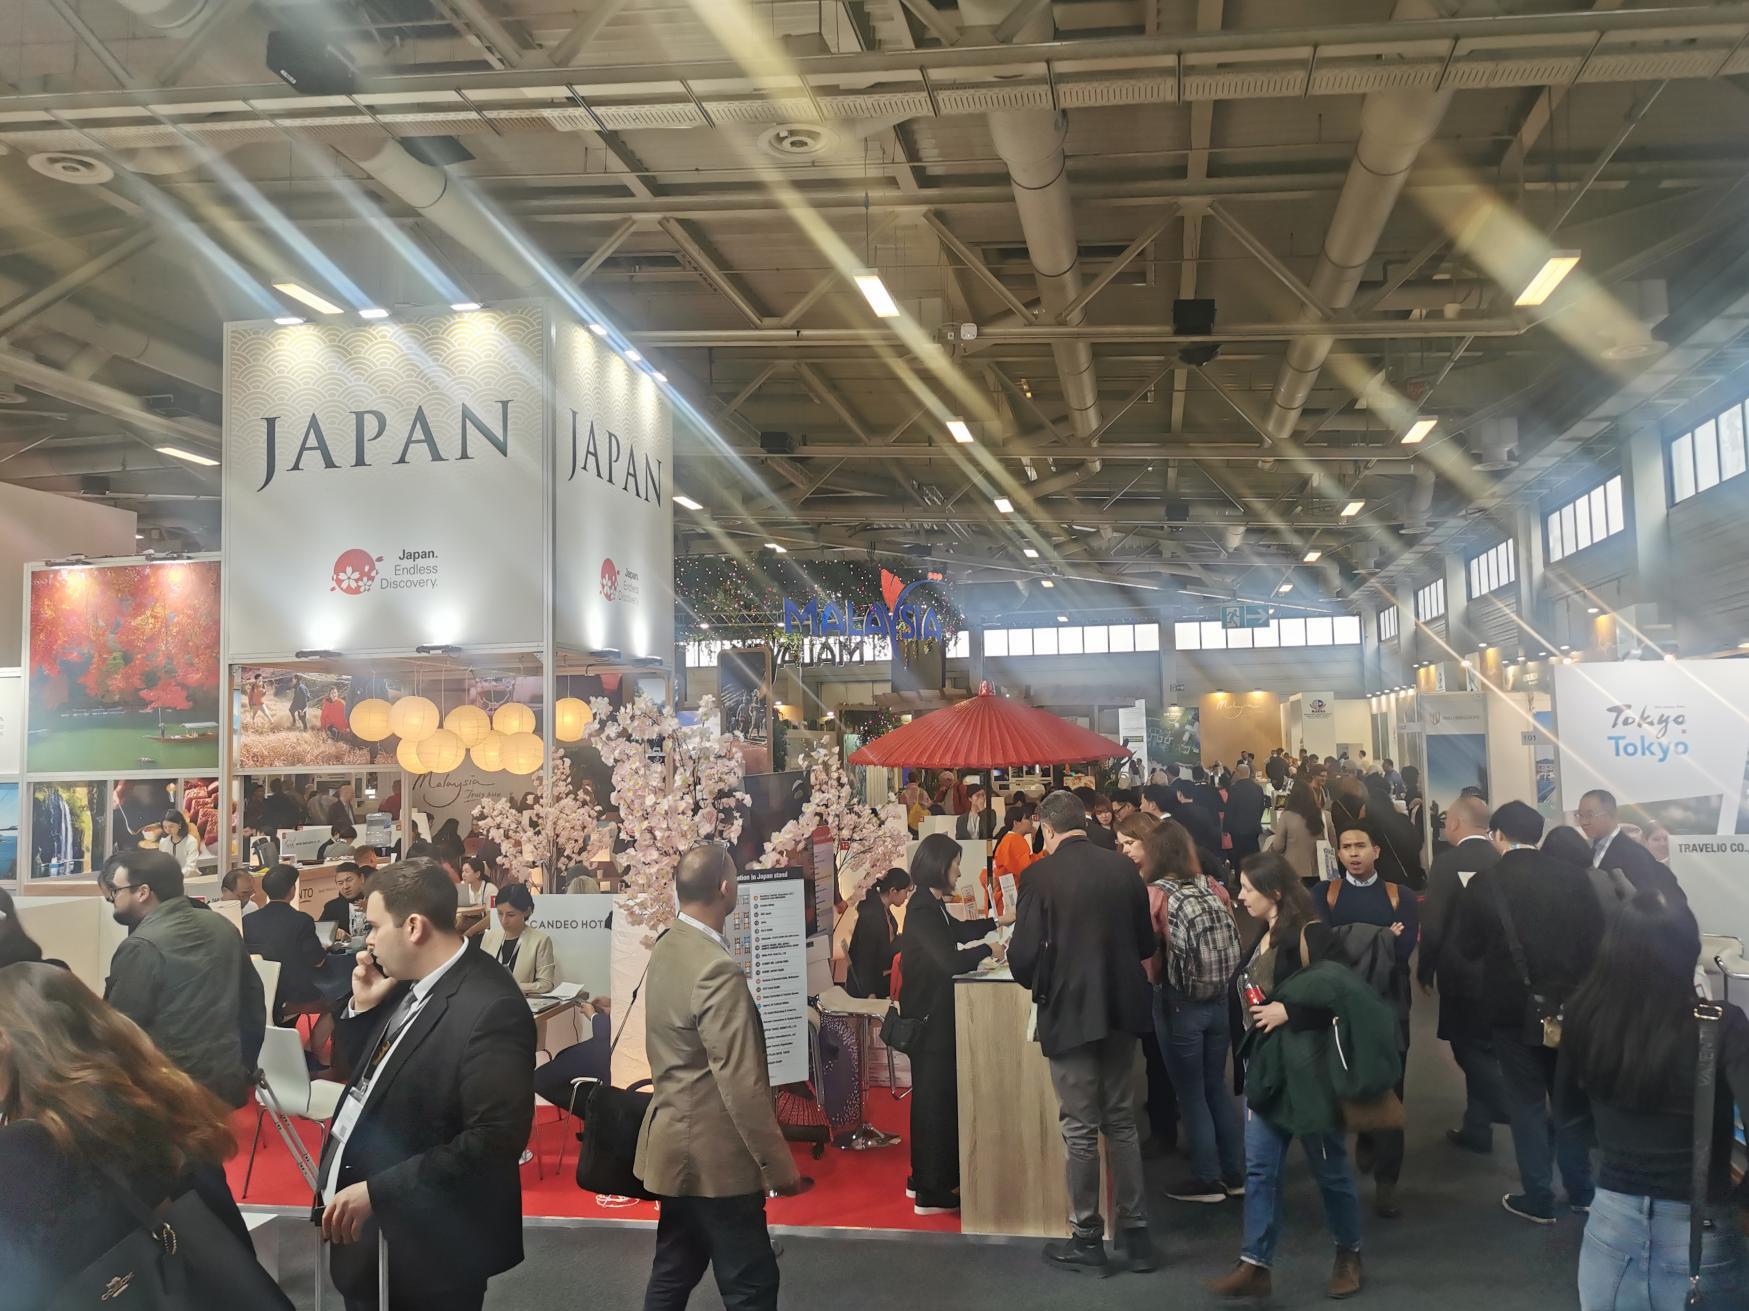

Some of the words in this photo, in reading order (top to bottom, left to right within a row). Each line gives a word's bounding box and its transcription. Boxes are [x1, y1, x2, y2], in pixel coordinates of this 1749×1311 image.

[256, 399, 514, 493] JAPAN
[567, 407, 662, 508] JAPAN
[399, 549, 438, 562] Japan.
[394, 564, 438, 576] Endless
[380, 577, 438, 591] Discovery.
[783, 588, 944, 656] MALAYSIA
[1606, 704, 1687, 740] Tokyo
[1607, 735, 1690, 763] Tokyo
[411, 770, 495, 808] Malaysia
[1678, 842, 1728, 853] TRAVELIO
[757, 872, 773, 880] Japan
[530, 919, 579, 929] CANDEO
[581, 920, 605, 929] HOT
